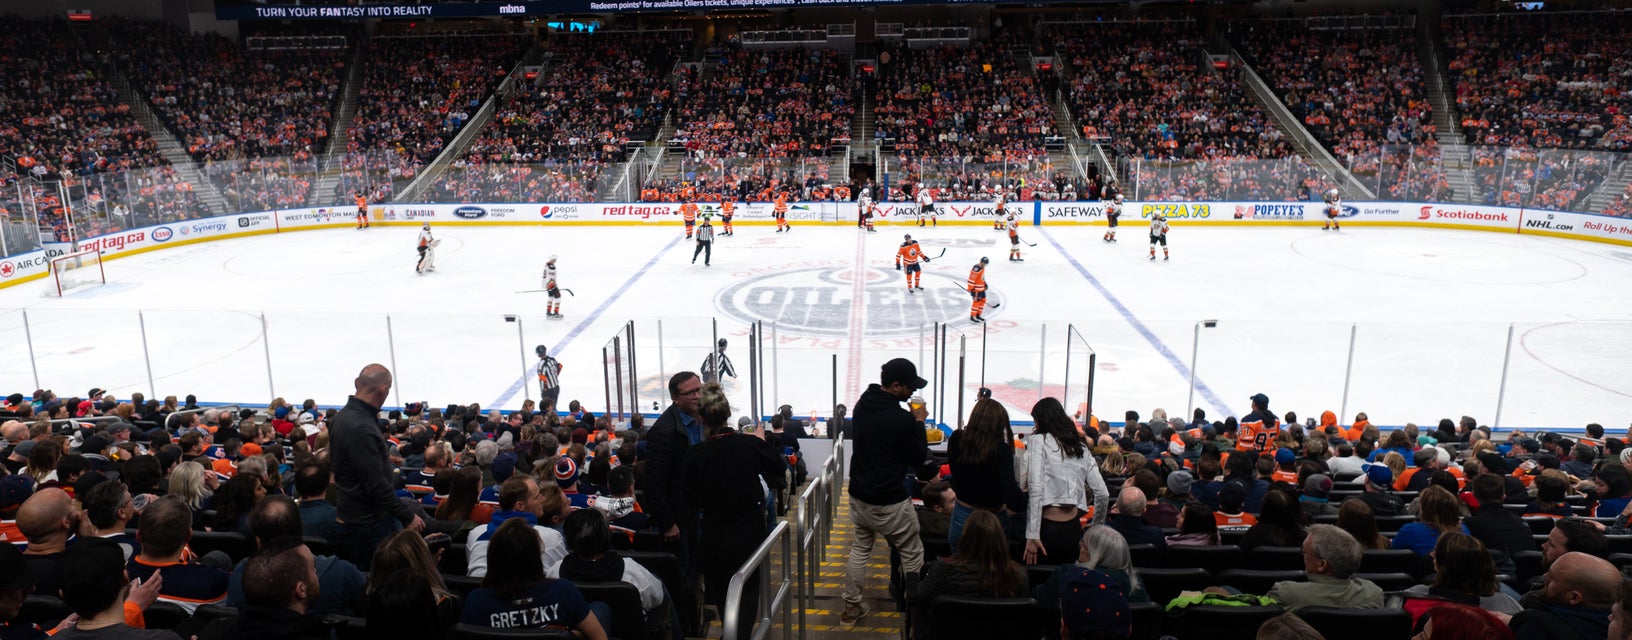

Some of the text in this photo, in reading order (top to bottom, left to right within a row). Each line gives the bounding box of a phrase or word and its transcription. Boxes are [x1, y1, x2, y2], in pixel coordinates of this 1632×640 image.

[500, 4, 526, 14] mbna
[590, 2, 618, 10] Redeem
[643, 1, 652, 9] for
[654, 0, 683, 8] available
[256, 5, 433, 17] TURN YOUR FANTASY INTO REALITY
[405, 209, 435, 217] CANADIAN
[553, 206, 578, 214] pepsi
[894, 206, 917, 216] JACK
[971, 206, 996, 216] JACK
[1048, 206, 1103, 218] SAFEWAY
[1142, 203, 1211, 218] PIZZA 73
[1254, 204, 1304, 216] POPEYE'S
[304, 212, 341, 220] EDMONTON
[1436, 209, 1508, 222] Scotiabank
[192, 222, 227, 233] Synergy
[1583, 221, 1602, 231] Roll
[1604, 223, 1618, 233] Up
[154, 231, 171, 239] Esso
[17, 261, 33, 270] AIR
[748, 286, 967, 306] OILERS
[490, 603, 559, 629] GRETZKY
